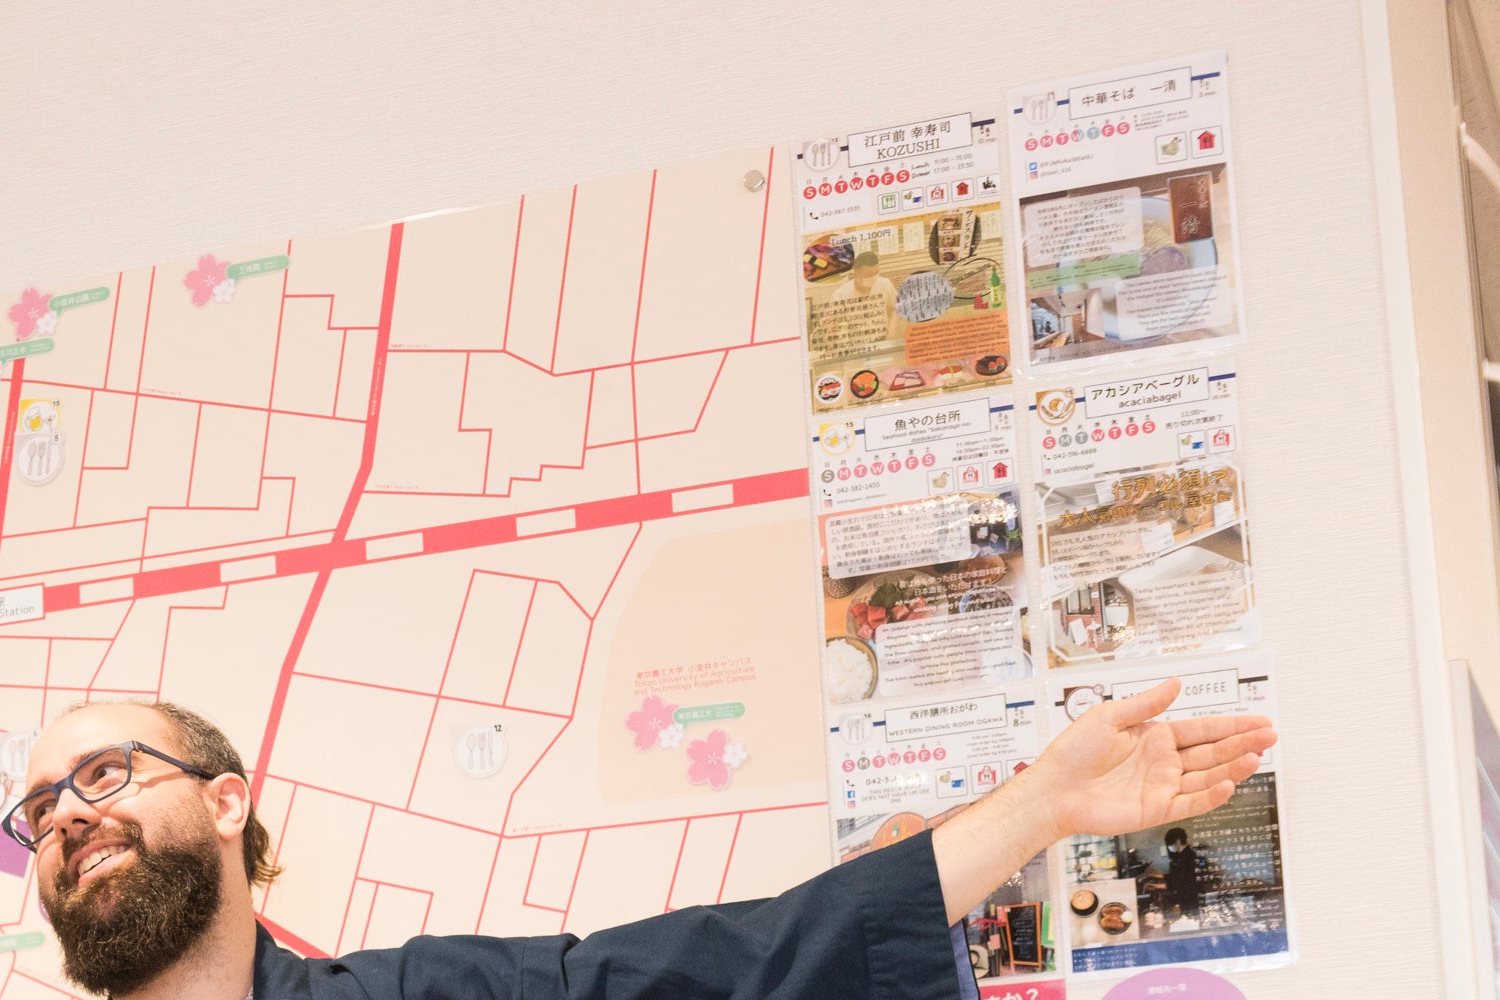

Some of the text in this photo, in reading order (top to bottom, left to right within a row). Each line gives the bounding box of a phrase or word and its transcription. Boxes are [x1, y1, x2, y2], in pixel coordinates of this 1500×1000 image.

[1082, 79, 1177, 107] 中華そば 一清
[865, 120, 952, 149] 江戸前 幸寿司
[877, 138, 941, 160] KOZUSHI
[831, 228, 891, 247] Lunch 1,100円
[1092, 374, 1200, 400] アカシアベーグル
[1118, 390, 1182, 409] acaciabagel
[895, 410, 961, 432] 魚やの台所
[836, 481, 881, 494] 042-382-1455
[0, 605, 35, 618] Station
[635, 678, 656, 688] Tokyo
[657, 674, 698, 685] University
[711, 666, 756, 678] Agriculture
[636, 656, 752, 679] 東京農工大学 小金井キャンパス
[650, 683, 693, 694] Technology
[694, 678, 725, 689] Koganei
[726, 674, 757, 684] Campus
[1184, 681, 1227, 697] COFFEE
[910, 702, 979, 720] 西洋膳所おがわ
[888, 716, 1004, 737] WESTERN DINING ROOM OGAWA
[1013, 718, 1020, 728] 8
